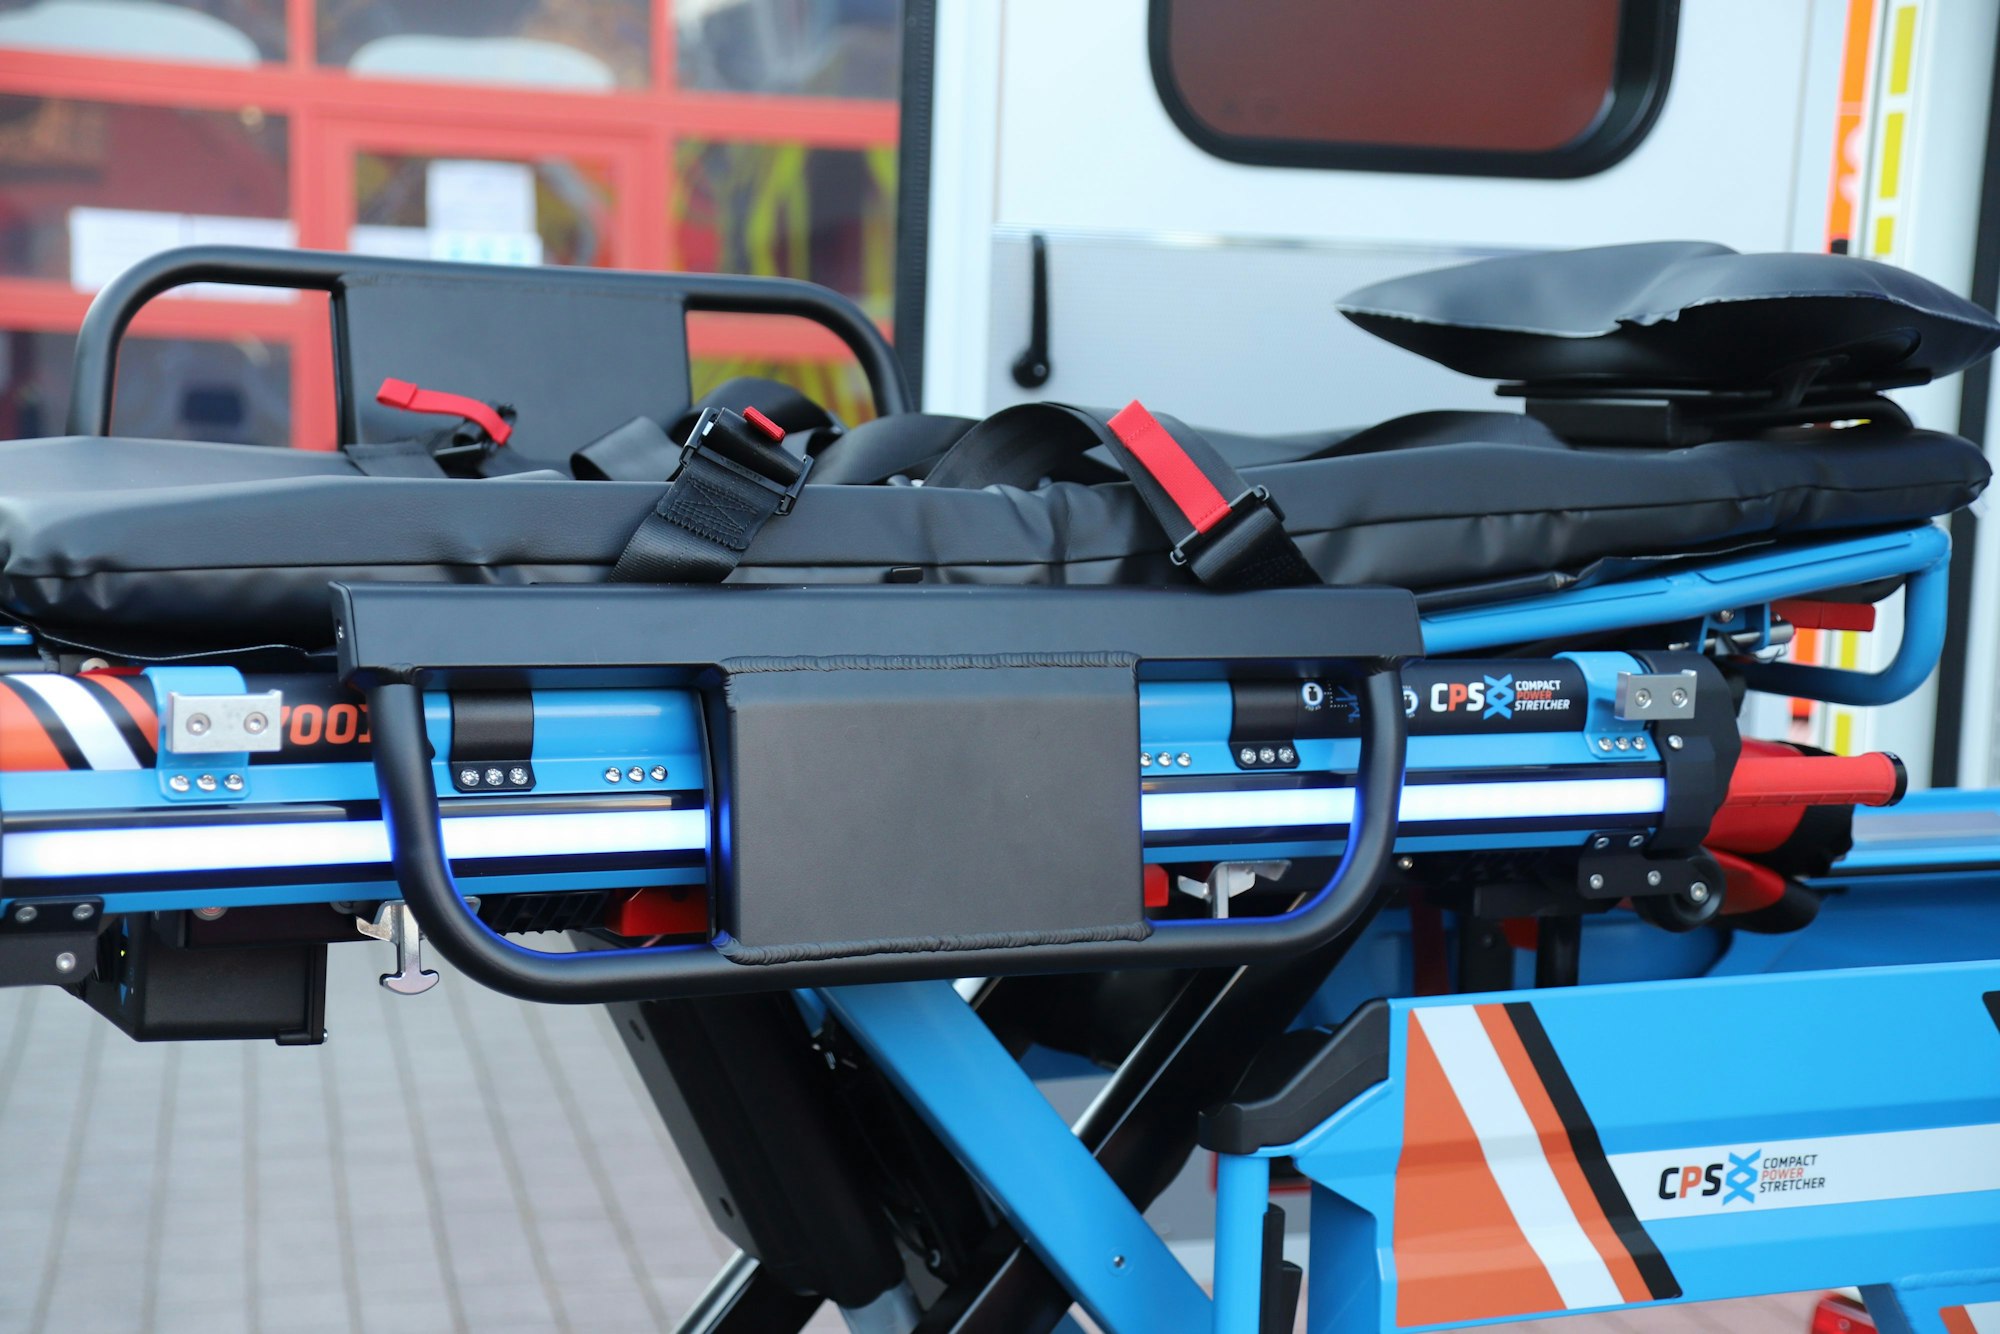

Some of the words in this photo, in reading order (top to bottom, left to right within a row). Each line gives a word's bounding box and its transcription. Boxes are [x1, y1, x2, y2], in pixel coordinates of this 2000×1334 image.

[1515, 680, 1561, 691] COMPACT
[1516, 690, 1552, 700] POWER
[1514, 699, 1571, 711] STRETCHER
[1763, 1154, 1818, 1169] COMPACT
[1761, 1168, 1804, 1181] POWER
[1759, 1177, 1826, 1193] STRETCHER
